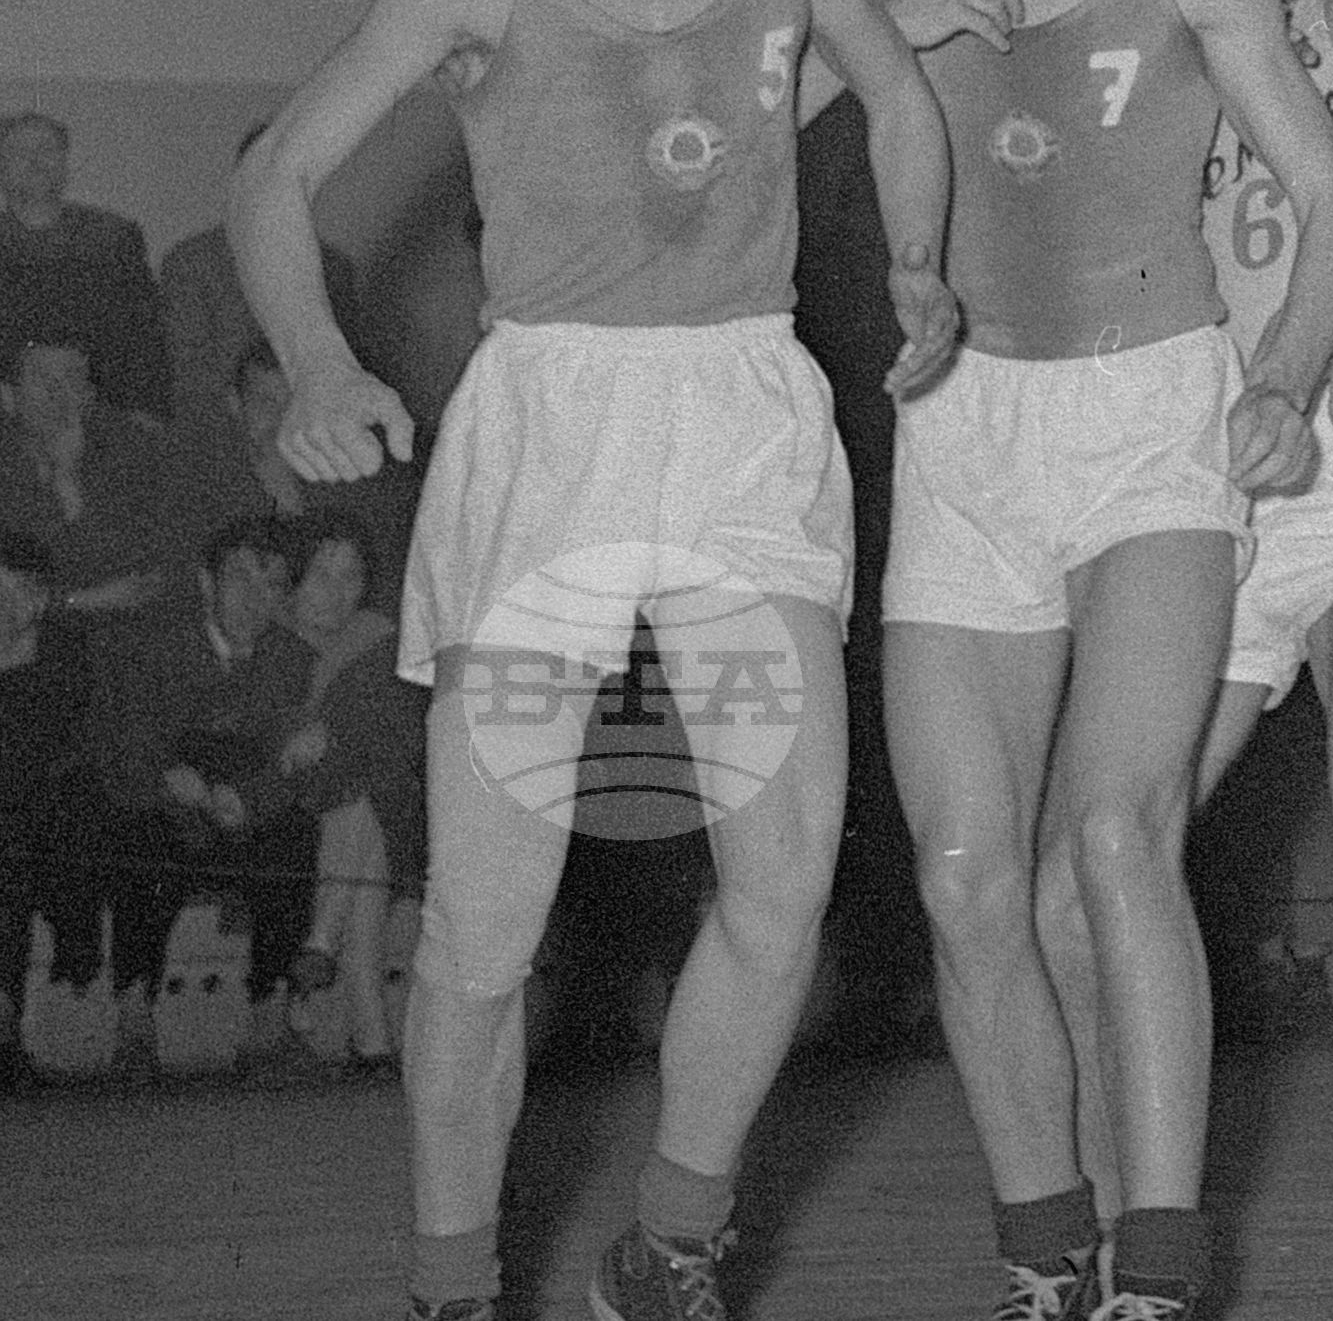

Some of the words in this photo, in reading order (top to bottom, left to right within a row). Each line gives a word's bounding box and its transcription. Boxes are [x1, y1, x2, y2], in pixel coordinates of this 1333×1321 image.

[759, 26, 795, 112] 5
[1089, 49, 1140, 126] 7
[1232, 178, 1287, 270] 6
